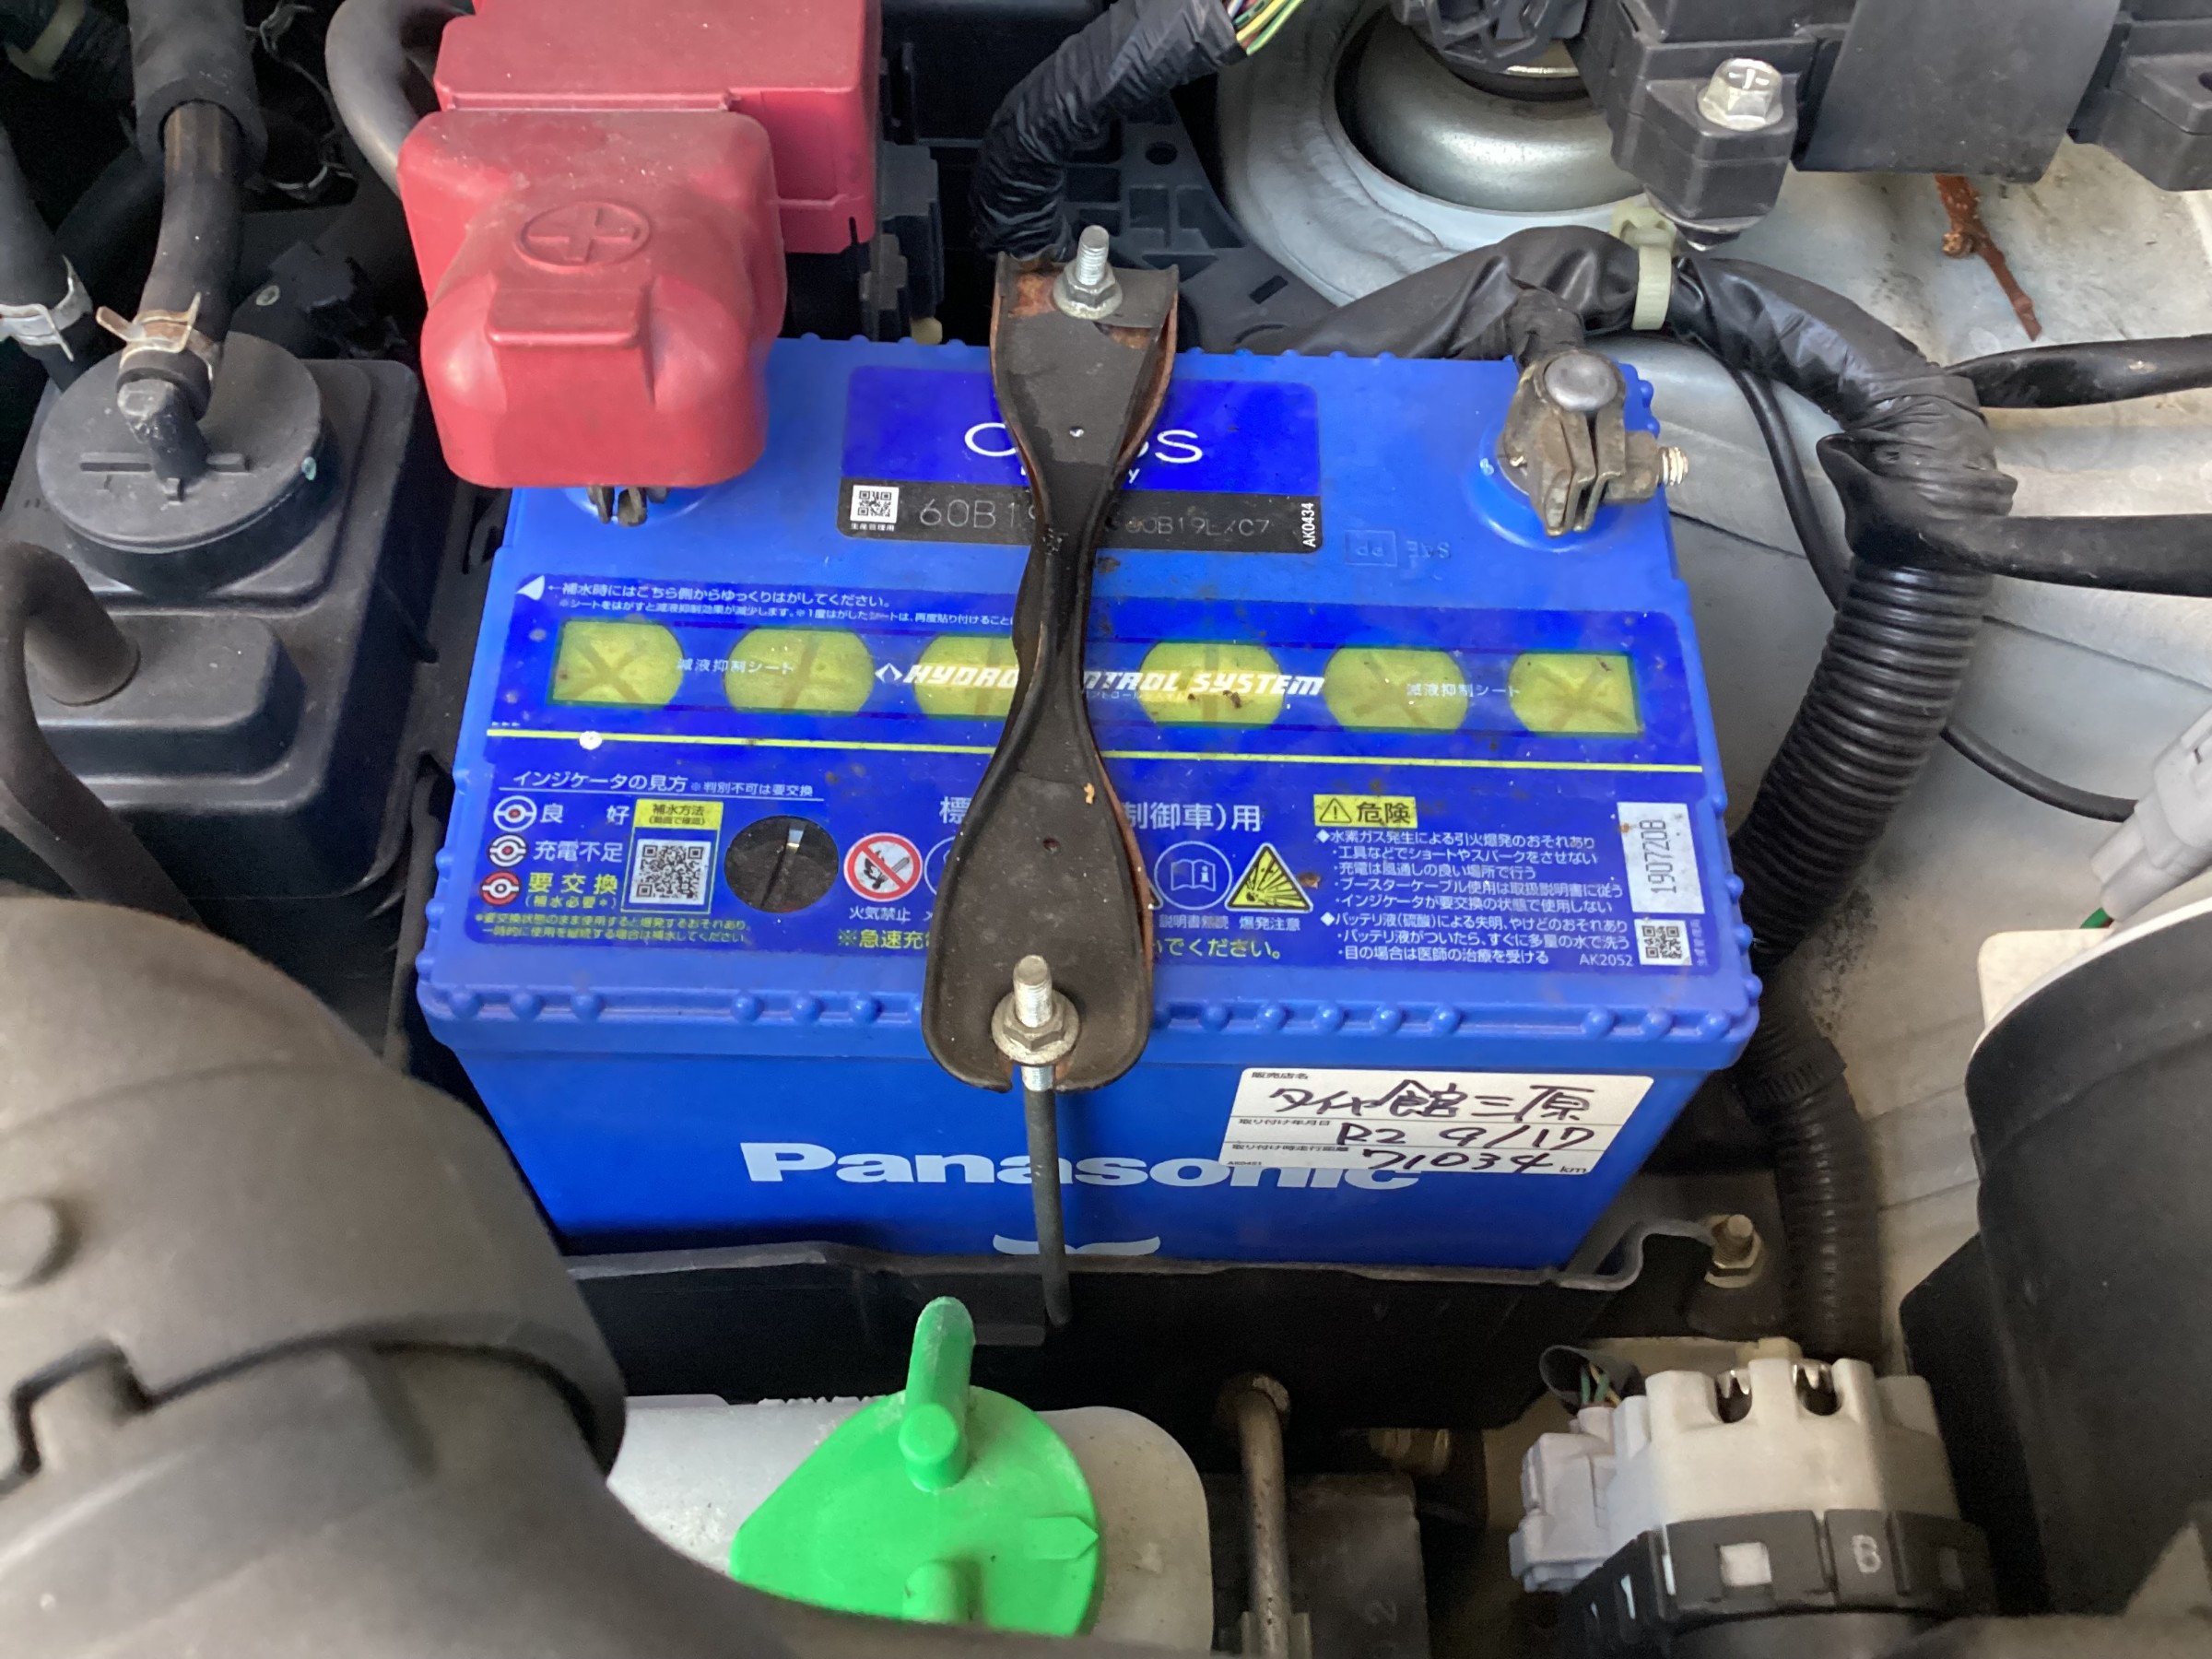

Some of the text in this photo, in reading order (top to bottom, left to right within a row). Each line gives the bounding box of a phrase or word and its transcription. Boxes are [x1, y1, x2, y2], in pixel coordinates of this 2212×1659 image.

[1300, 502, 1316, 547] AK0434
[1082, 671, 1182, 692] NTROL
[1190, 674, 1325, 696] SYSTEM
[512, 771, 688, 794] インジケータの見方
[652, 803, 706, 816] 補水方法
[1357, 801, 1411, 825] 危険
[533, 840, 624, 864] 充電不足
[849, 907, 911, 923] 火気禁止
[1239, 915, 1301, 932] 爆発注意
[838, 929, 929, 949] ※急速充
[1579, 953, 1634, 968] AK2052
[1559, 1164, 1588, 1175] km
